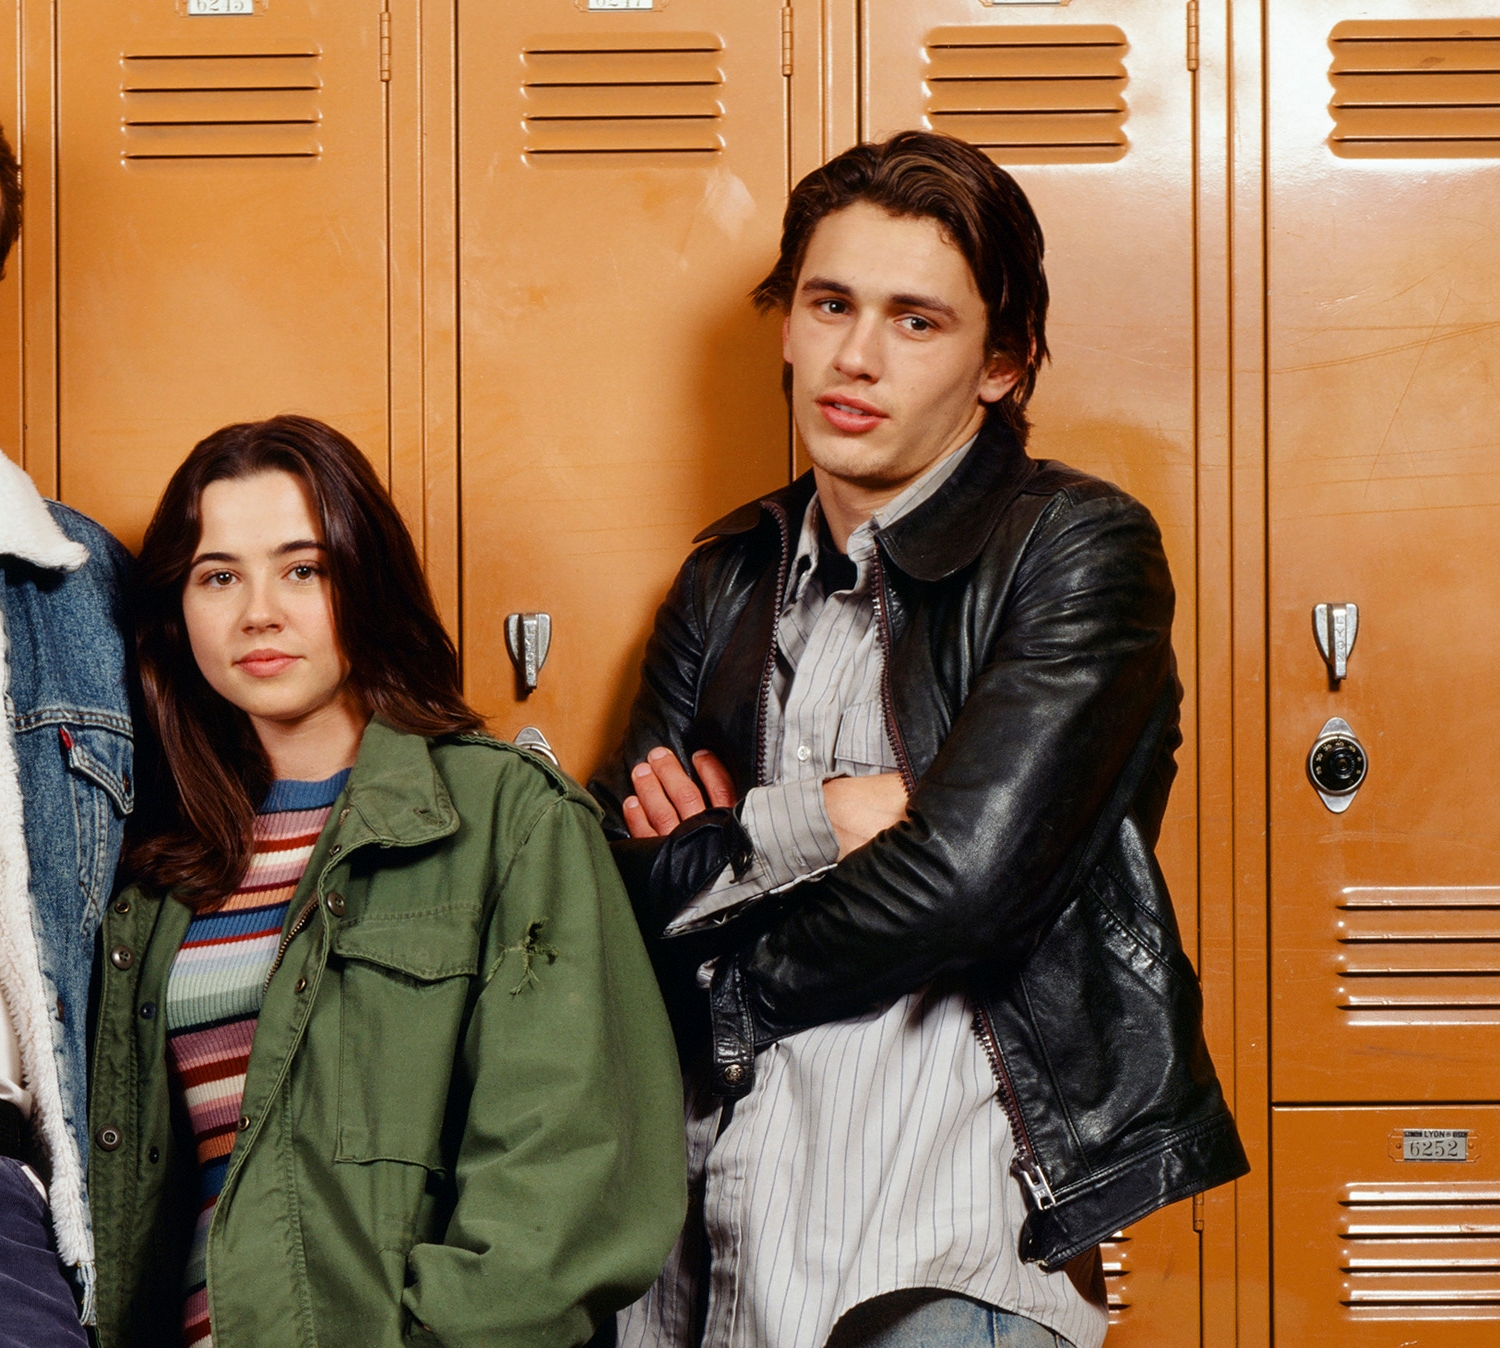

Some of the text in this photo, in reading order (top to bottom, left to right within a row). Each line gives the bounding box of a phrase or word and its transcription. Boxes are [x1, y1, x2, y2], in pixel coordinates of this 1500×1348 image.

[1335, 615, 1346, 663] LYON
[1424, 1130, 1445, 1138] LYON
[1410, 1140, 1458, 1157] 6252
